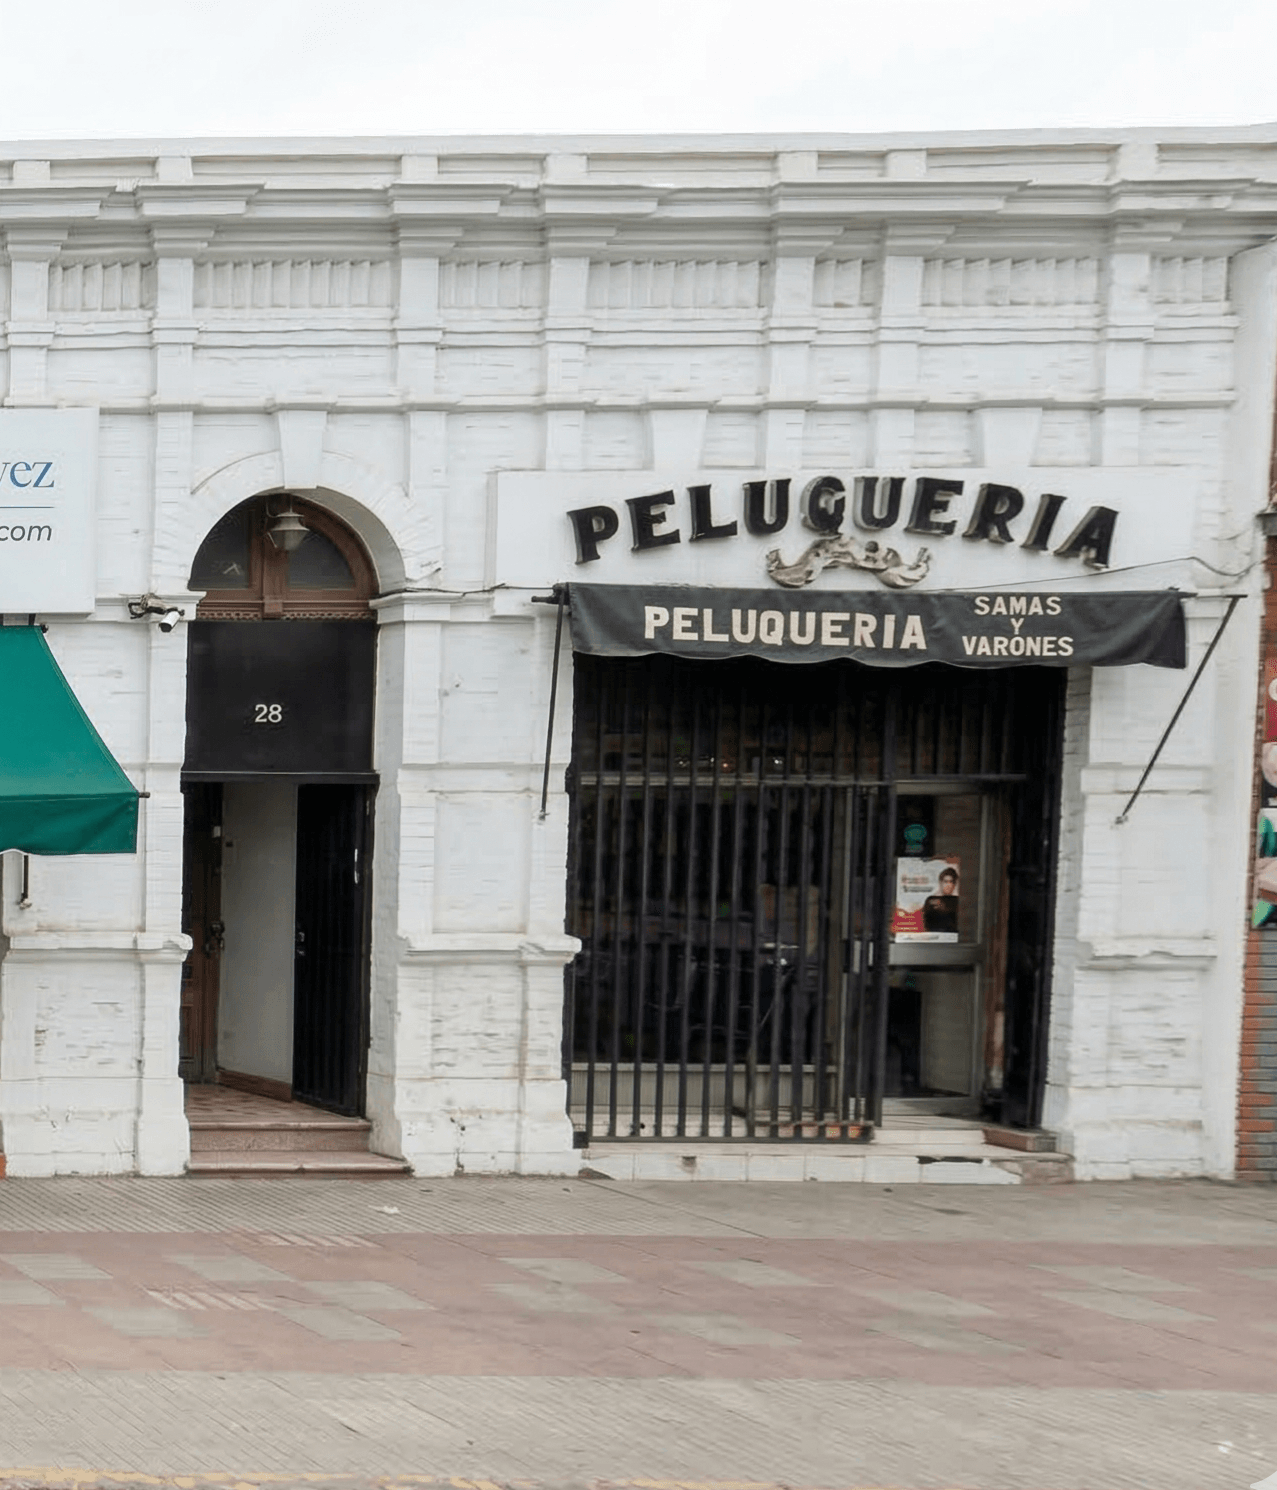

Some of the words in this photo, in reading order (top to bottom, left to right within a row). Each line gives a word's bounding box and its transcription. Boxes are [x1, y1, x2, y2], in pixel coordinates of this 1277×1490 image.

[974, 595, 1062, 616] SAMAS
[644, 605, 928, 650] PELUQUERIA
[1010, 617, 1025, 635] Y
[961, 635, 1074, 657] VARONES
[254, 703, 283, 723] 28
